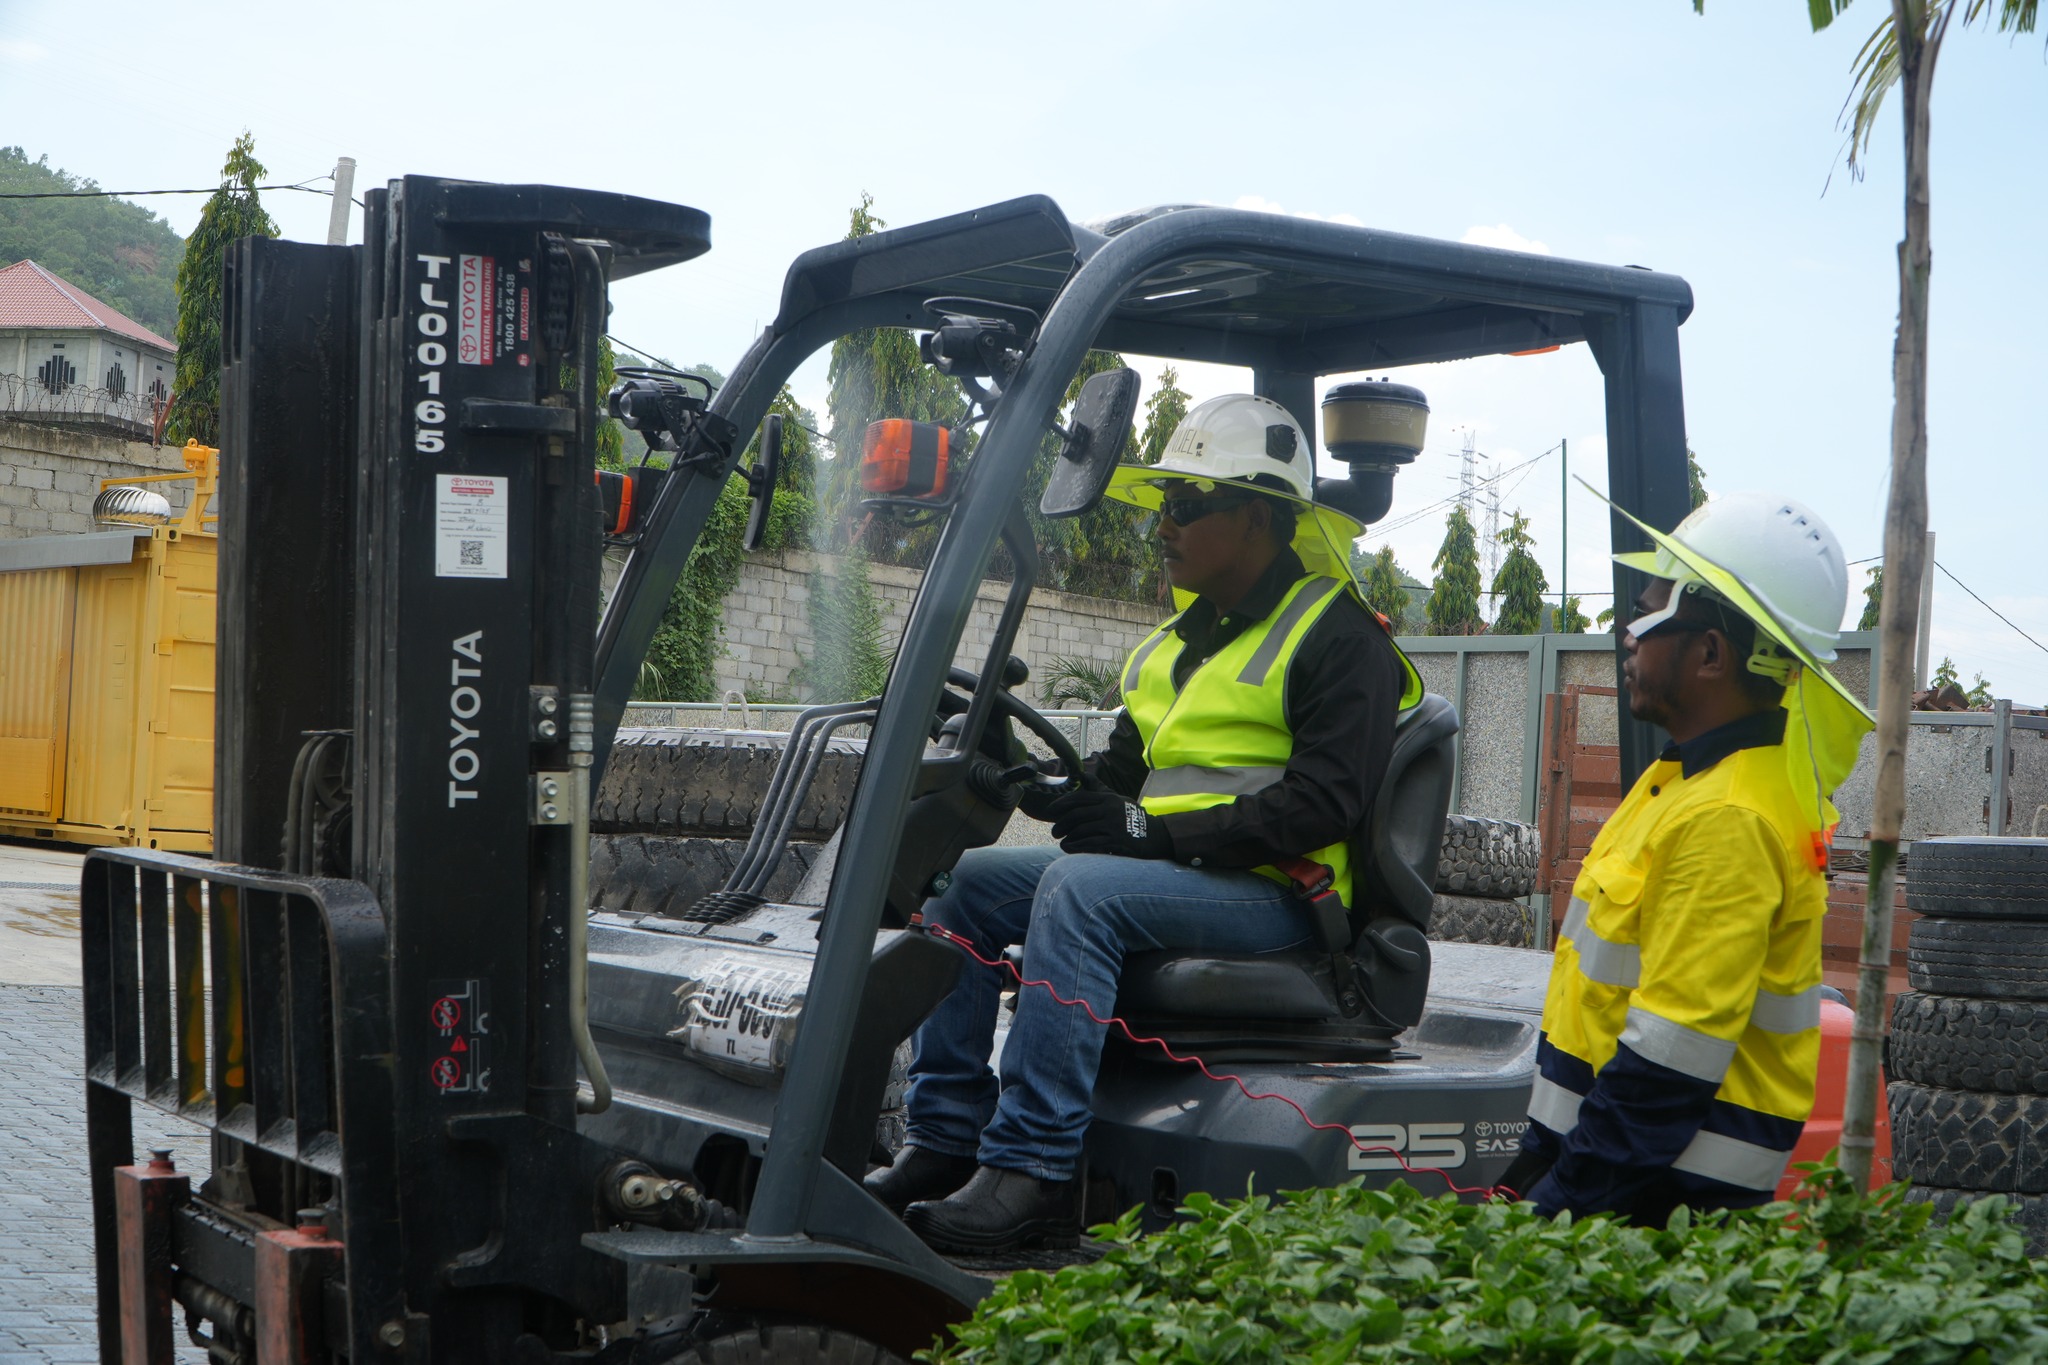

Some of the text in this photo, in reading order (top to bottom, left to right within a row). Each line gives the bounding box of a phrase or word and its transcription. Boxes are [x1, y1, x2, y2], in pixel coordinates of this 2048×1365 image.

[462, 257, 476, 331] TOYOTA
[483, 262, 492, 360] MATERIAL HANDLING
[505, 274, 516, 352] 1800 425 438
[416, 254, 451, 453] TL00165
[464, 479, 494, 487] TOYOTA
[449, 630, 483, 807] TOYOTA
[1348, 1123, 1466, 1170] 25
[1476, 1138, 1520, 1152] SAS
[1493, 1122, 1531, 1135] TOYOT
